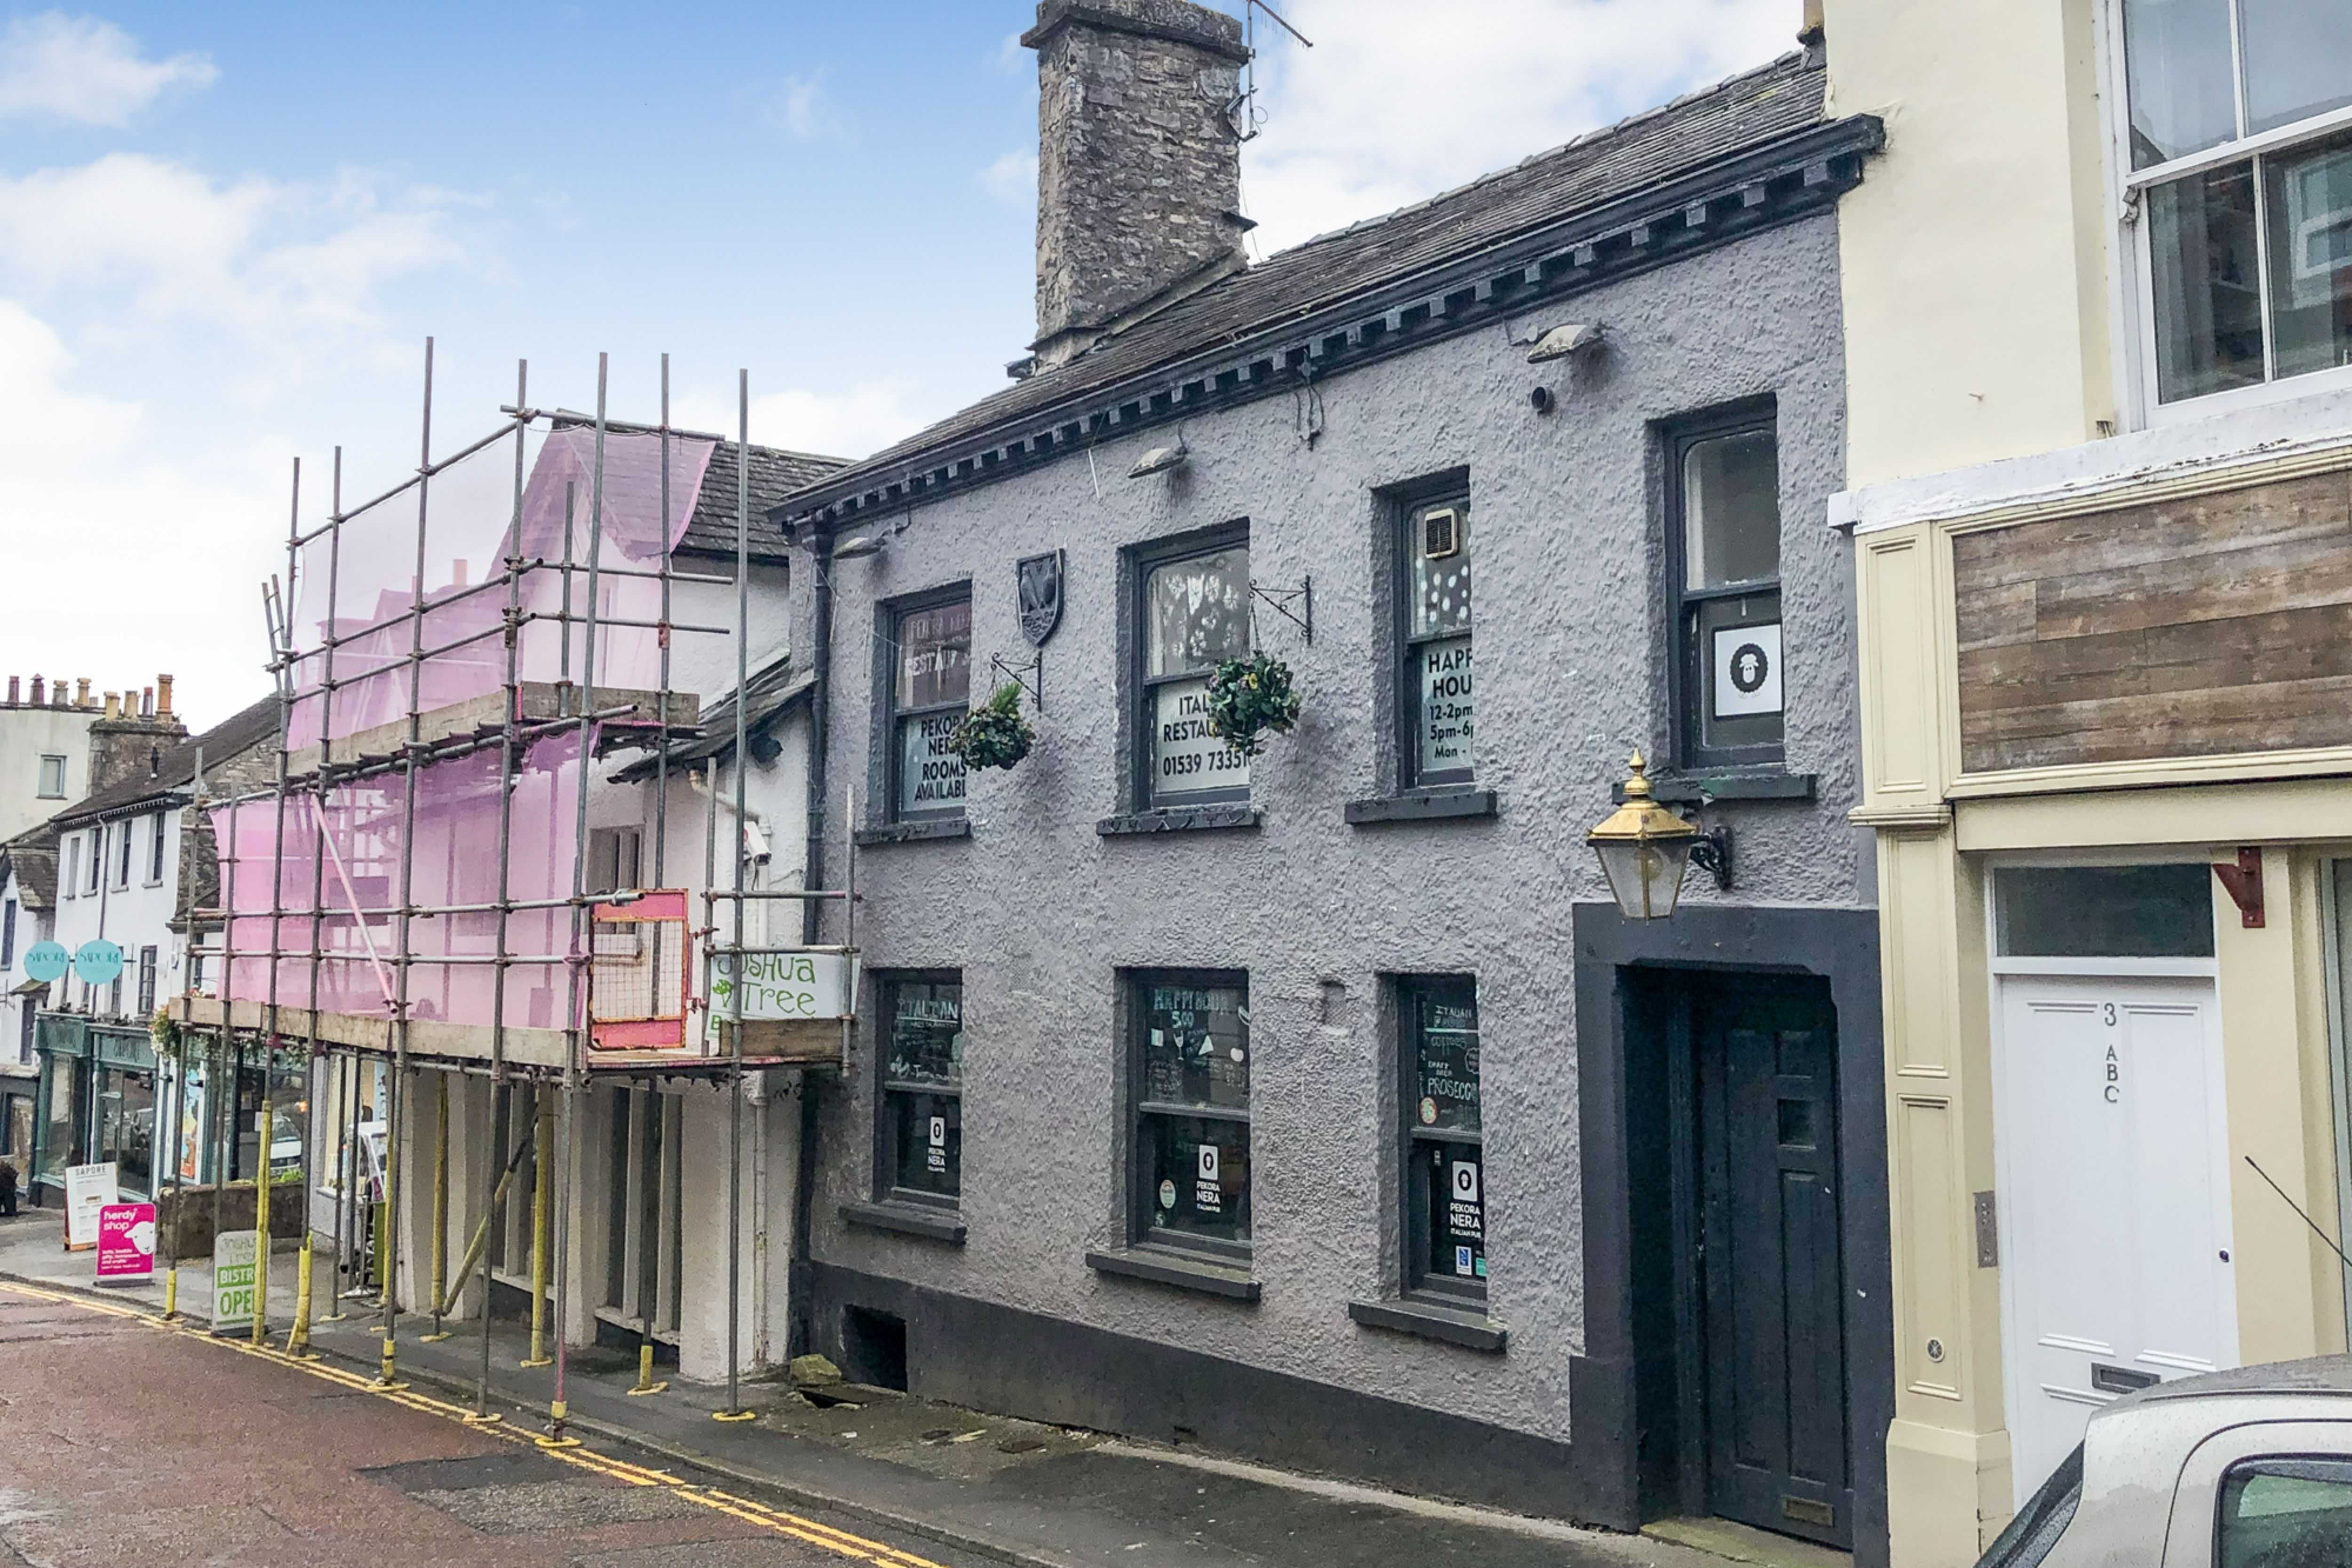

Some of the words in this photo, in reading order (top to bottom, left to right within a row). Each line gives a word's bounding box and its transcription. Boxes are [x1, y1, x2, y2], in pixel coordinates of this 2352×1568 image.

[1429, 647, 1473, 673] HAPP
[1433, 674, 1472, 699] HOU
[923, 760, 967, 781] ROOMS
[1163, 754, 1202, 776] 01539
[1208, 750, 1250, 772] 73351
[914, 779, 966, 802] AVAILABL
[2104, 1003, 2117, 1027] 3
[75, 1165, 106, 1176] SAPORE
[1197, 1190, 1220, 1204] NERA
[104, 1210, 135, 1220] herdy
[1450, 1203, 1480, 1215] PEKORA
[103, 1221, 129, 1231] shop
[1450, 1213, 1481, 1229] NERA
[220, 1268, 256, 1284] BISTR
[220, 1289, 252, 1316] OPE
